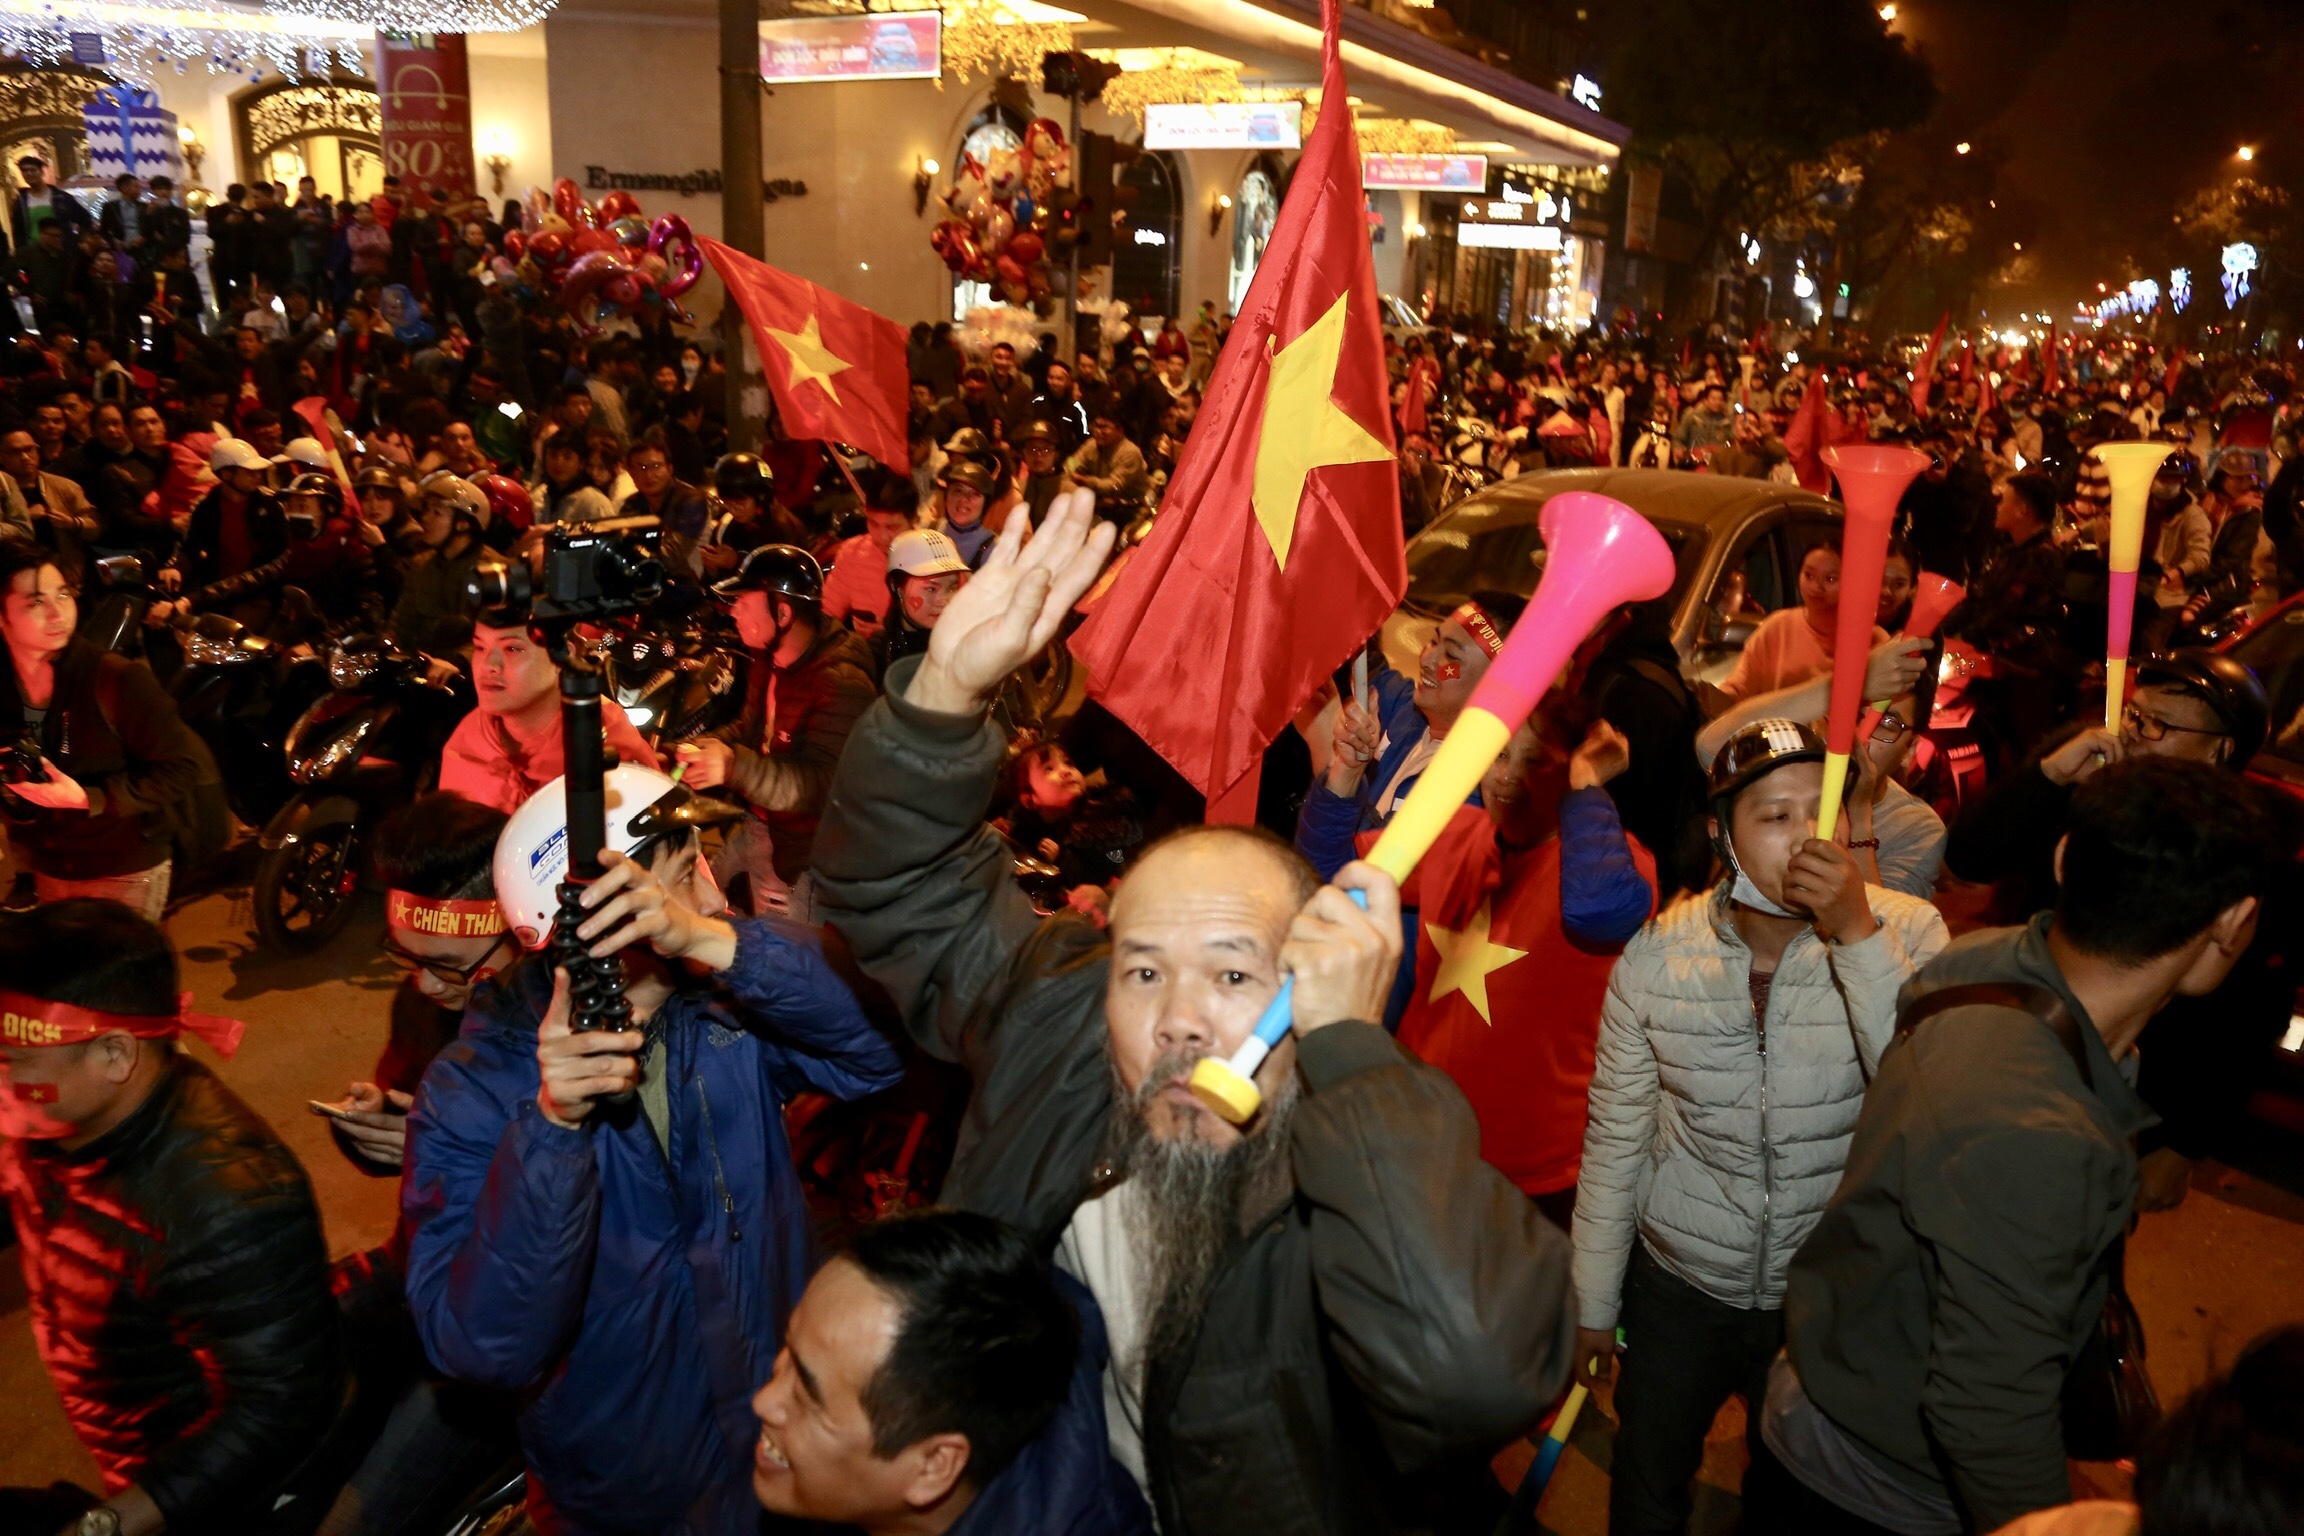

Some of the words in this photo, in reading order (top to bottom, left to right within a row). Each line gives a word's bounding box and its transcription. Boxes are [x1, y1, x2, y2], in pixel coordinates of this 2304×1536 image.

[569, 540, 593, 548] Canon
[1947, 743, 1979, 760] YAMAHA
[413, 900, 460, 935] CHIẾN
[465, 900, 502, 935] THẮN
[3, 1012, 62, 1045] ĐỊCH
